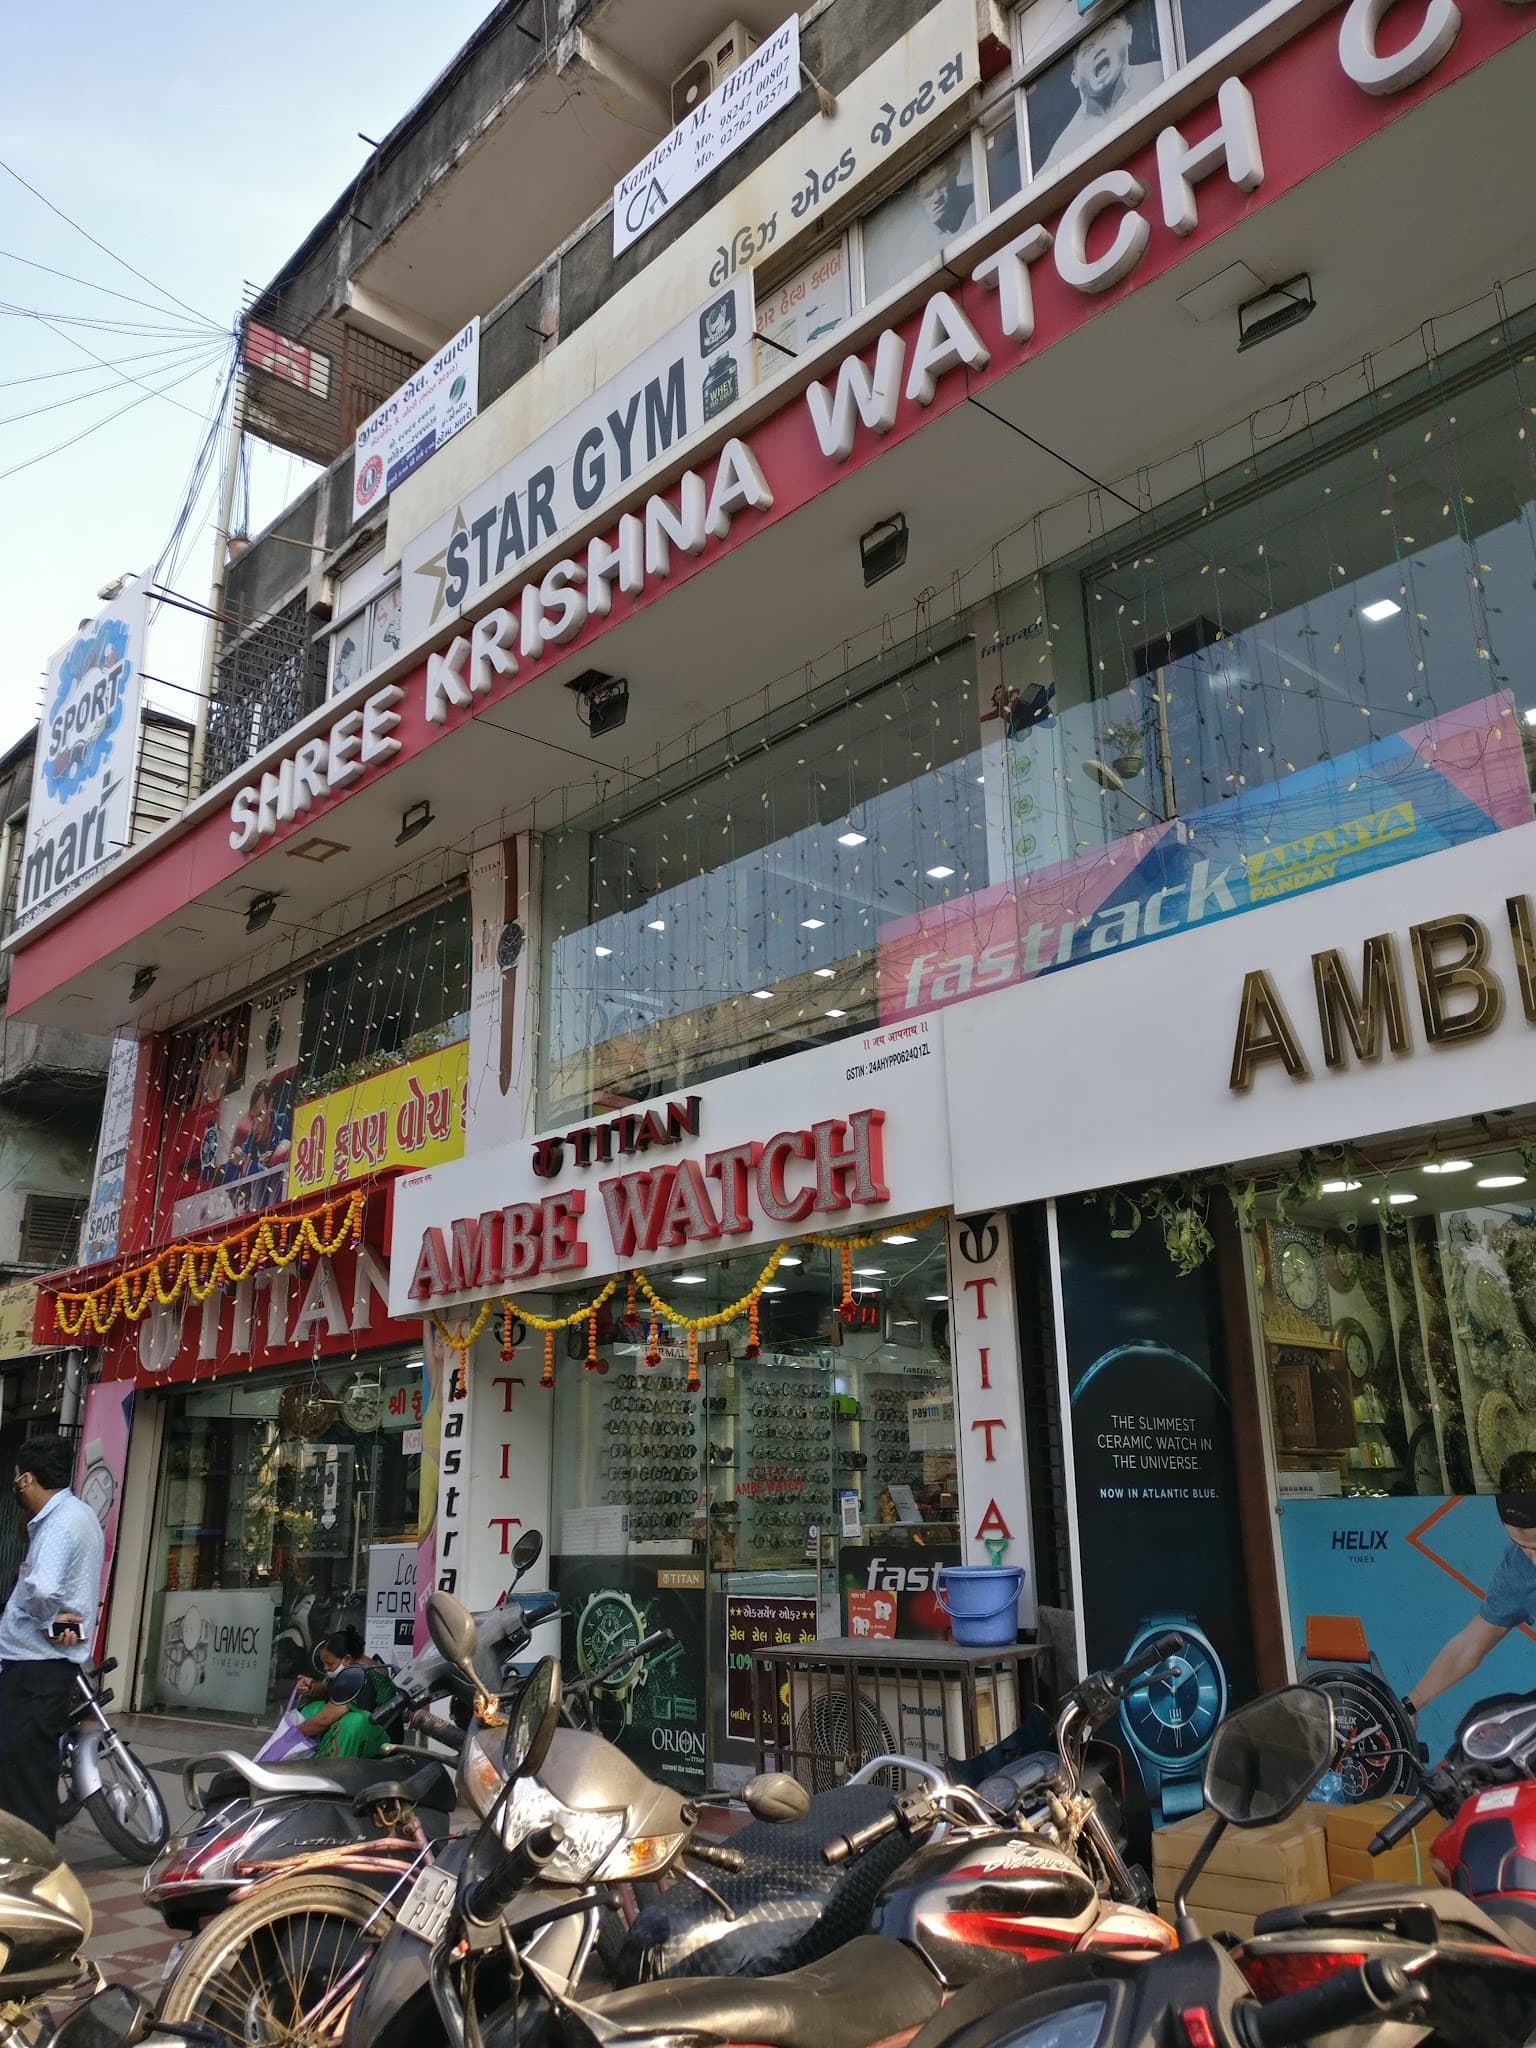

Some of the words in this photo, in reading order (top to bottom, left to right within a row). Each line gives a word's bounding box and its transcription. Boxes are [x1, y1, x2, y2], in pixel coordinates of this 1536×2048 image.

[1338, 0, 1535, 97] C
[619, 127, 684, 201] Kamlesh
[690, 102, 712, 135] M.
[721, 29, 790, 106] Hirpara
[720, 93, 752, 130] 98247
[756, 56, 790, 97] 00807
[720, 111, 752, 148] 92762
[756, 76, 790, 115] 02571
[709, 211, 777, 288] લેડિઝ
[791, 147, 856, 218] એન્ડ
[805, 76, 1265, 463] WATCH
[444, 466, 558, 609] STAR
[573, 360, 688, 511] GYM
[229, 684, 406, 852] SHREE
[426, 437, 773, 724] KRISHNA
[49, 663, 122, 757] SPORT
[1252, 804, 1413, 882] ANANYA
[905, 859, 1240, 1009] fastrack
[1250, 860, 1339, 902] PANDAY
[256, 984, 298, 1012] POLICE
[294, 1114, 326, 1186] શ્રી
[332, 1109, 388, 1182] કૃષ્ણ
[396, 1076, 451, 1151] વોચ
[567, 1095, 703, 1168] TITAN
[408, 1188, 587, 1300] AMBE
[599, 1108, 890, 1257] WATCH
[902, 1365, 938, 1376] fastrack
[963, 1277, 1015, 1540] TITA
[1111, 1415, 1136, 1430] THE
[1138, 1416, 1196, 1432] SLIMMEST
[404, 1432, 422, 1450] Kri
[1097, 1434, 1153, 1450] CERAMIC
[1155, 1437, 1198, 1451] WATCH
[1200, 1438, 1213, 1451] IN
[1112, 1454, 1137, 1469] THE
[1139, 1455, 1202, 1470] UNIVERSE.
[438, 1369, 464, 1595] fastra
[1100, 1487, 1124, 1499] NOW
[1128, 1487, 1139, 1499] IN
[1142, 1488, 1189, 1499] ATLANTIC
[1192, 1488, 1219, 1499] BLUE.
[1331, 1530, 1389, 1550] HELIX
[1348, 1556, 1376, 1564] TIMEX
[670, 1573, 700, 1585] TITAN
[866, 1557, 948, 1592] fast
[376, 1591, 416, 1613] FOR
[213, 1625, 260, 1655] LAMEX
[729, 1624, 745, 1641] સેલ
[751, 1626, 768, 1642] સેલ
[774, 1627, 791, 1643] સેલ
[798, 1628, 816, 1643] સેલ
[901, 1703, 944, 1718] Panasoni
[651, 1727, 706, 1756] ORION
